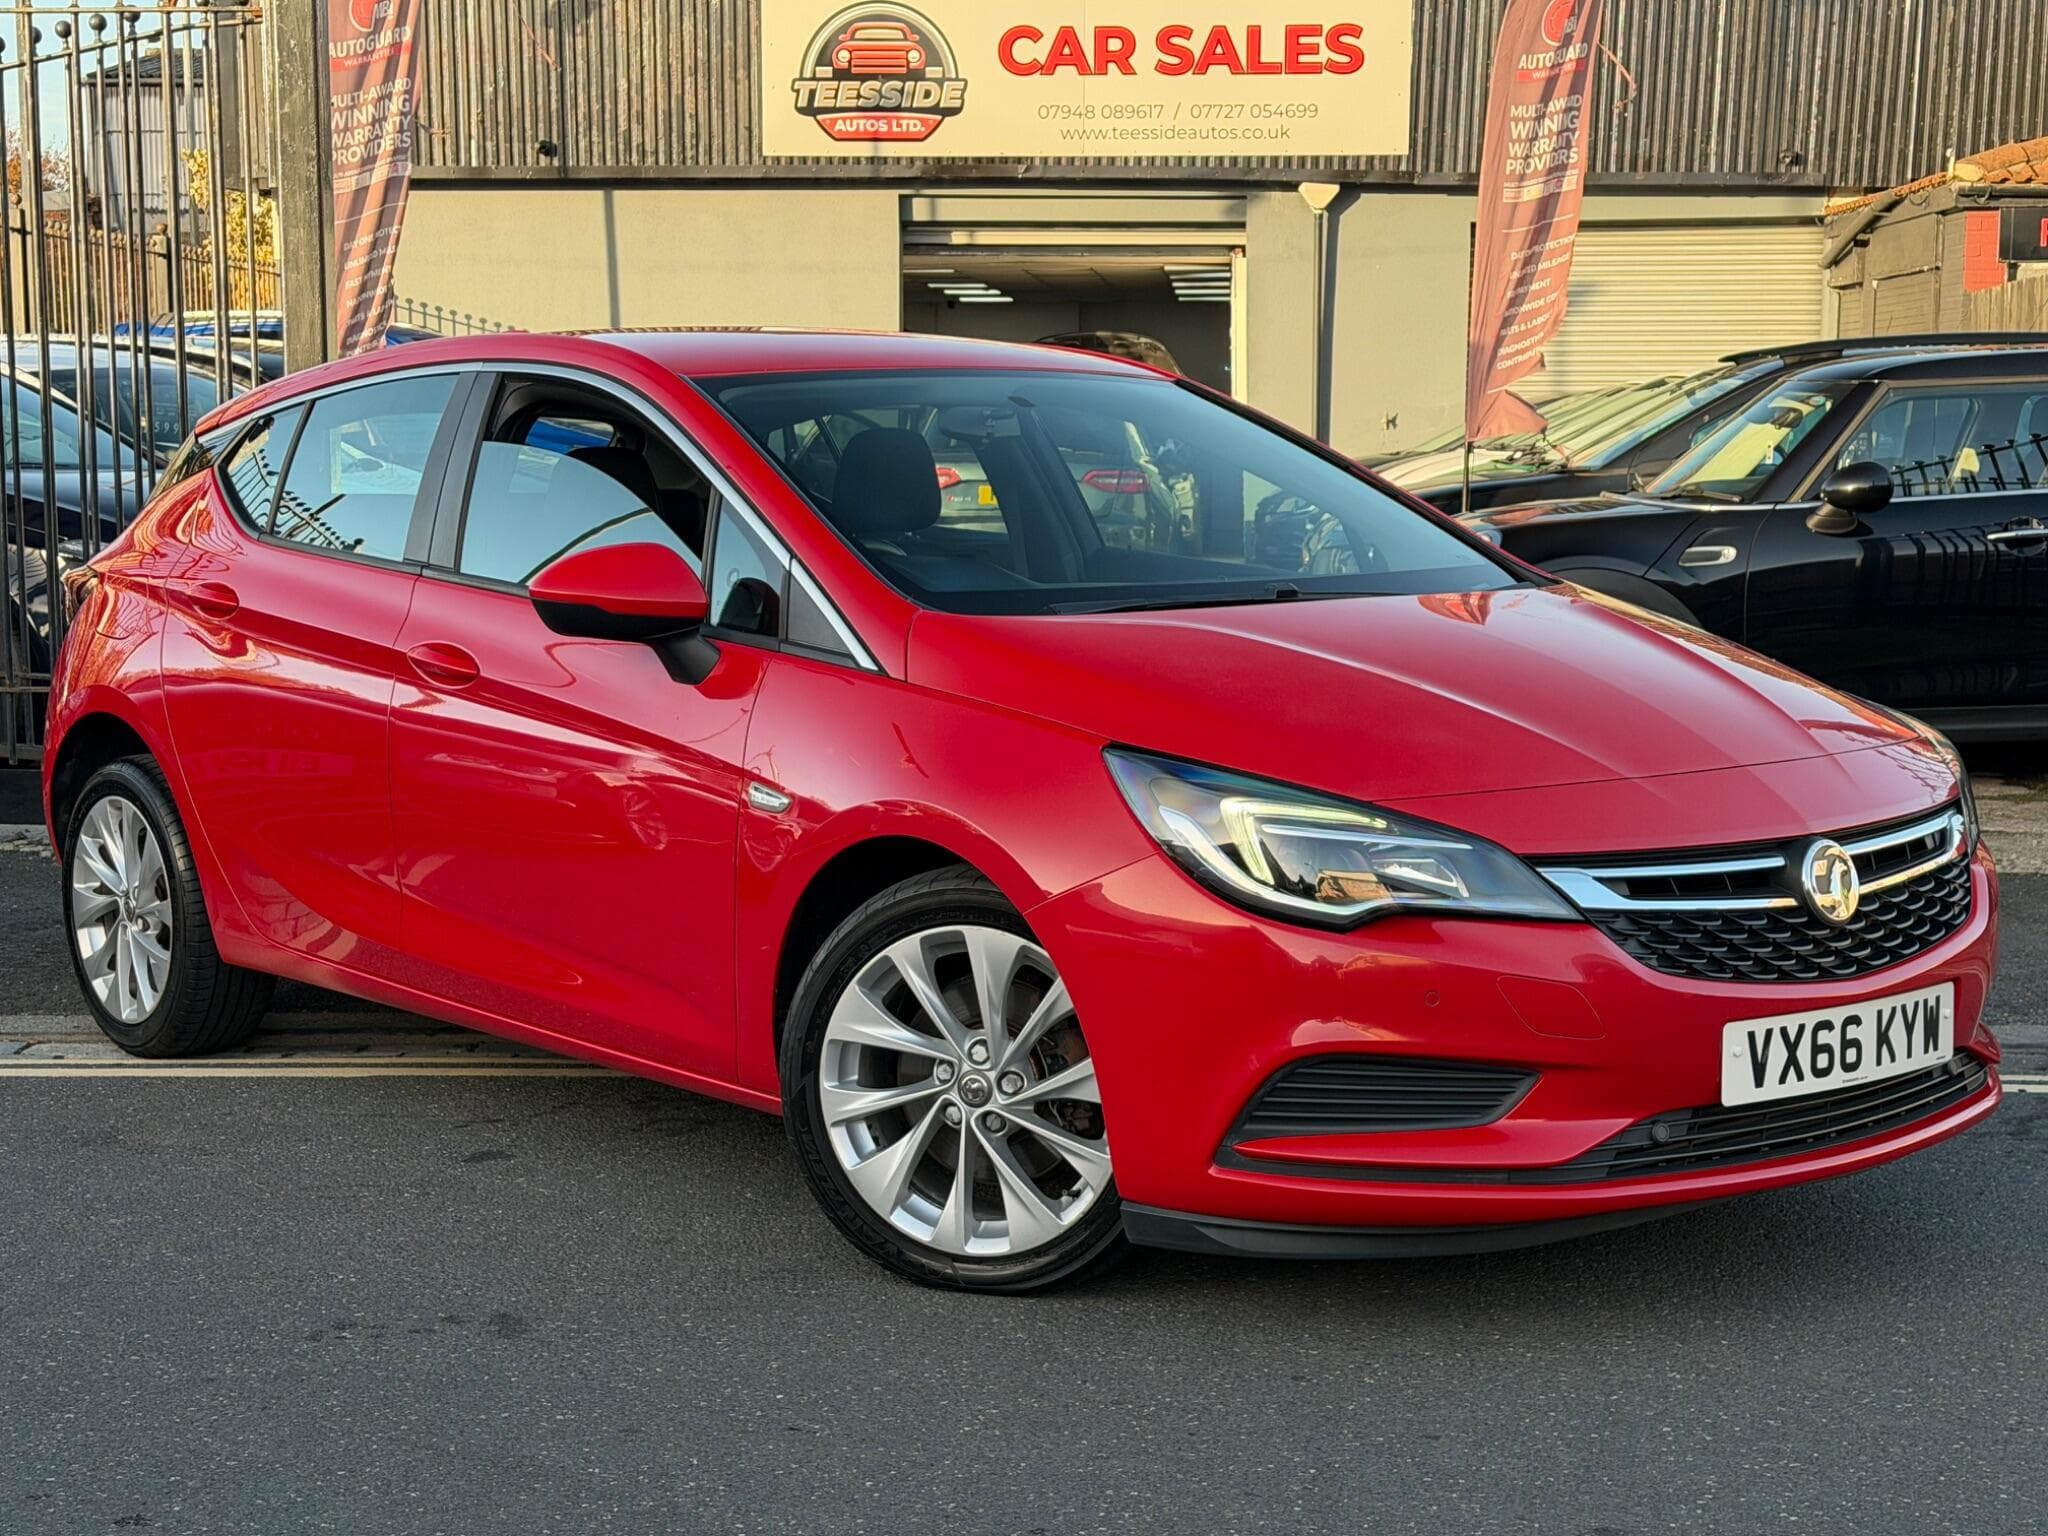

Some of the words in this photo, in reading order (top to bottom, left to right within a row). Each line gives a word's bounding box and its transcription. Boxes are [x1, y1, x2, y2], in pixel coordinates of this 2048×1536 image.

[329, 26, 411, 59] AUTOGUARD
[998, 24, 1137, 76] CAR
[1154, 23, 1365, 76] SALES
[793, 80, 966, 108] TEESSIDE
[834, 119, 889, 132] AUTOS
[891, 119, 926, 132] LTD.
[1038, 104, 1096, 120] 07948
[1101, 104, 1164, 120] 089617
[1190, 104, 1245, 119] 07727
[1250, 103, 1319, 119] 054699
[1060, 124, 1291, 140] www.teessideautos.co.uk
[1746, 1014, 1863, 1089] VX66
[1875, 995, 1940, 1067] KYW
